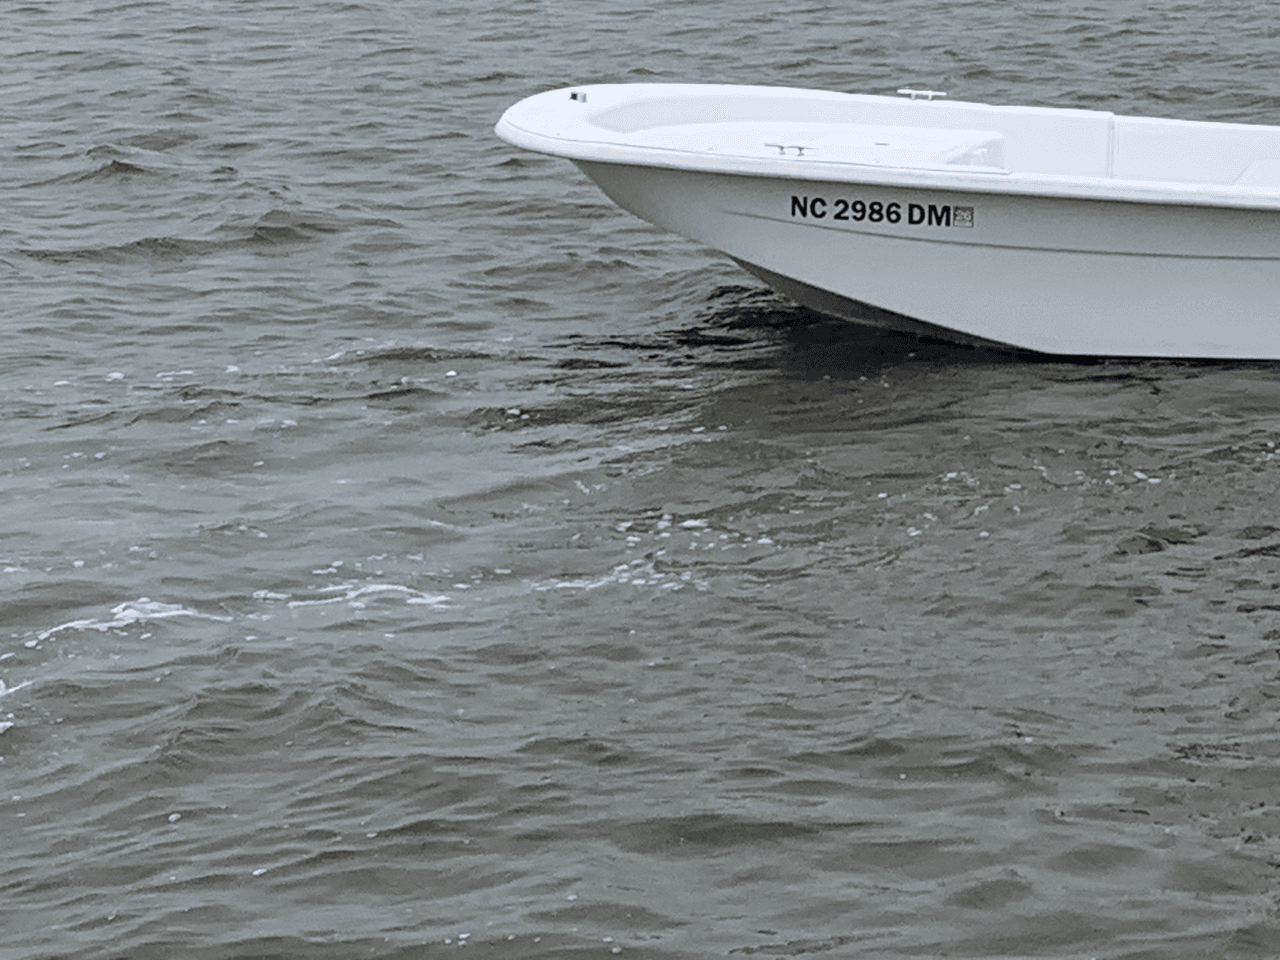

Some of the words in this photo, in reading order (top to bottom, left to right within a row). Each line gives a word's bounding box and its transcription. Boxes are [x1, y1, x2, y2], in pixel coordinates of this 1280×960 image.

[791, 196, 827, 219] NC
[833, 199, 901, 223] 2986
[908, 203, 951, 227] DM
